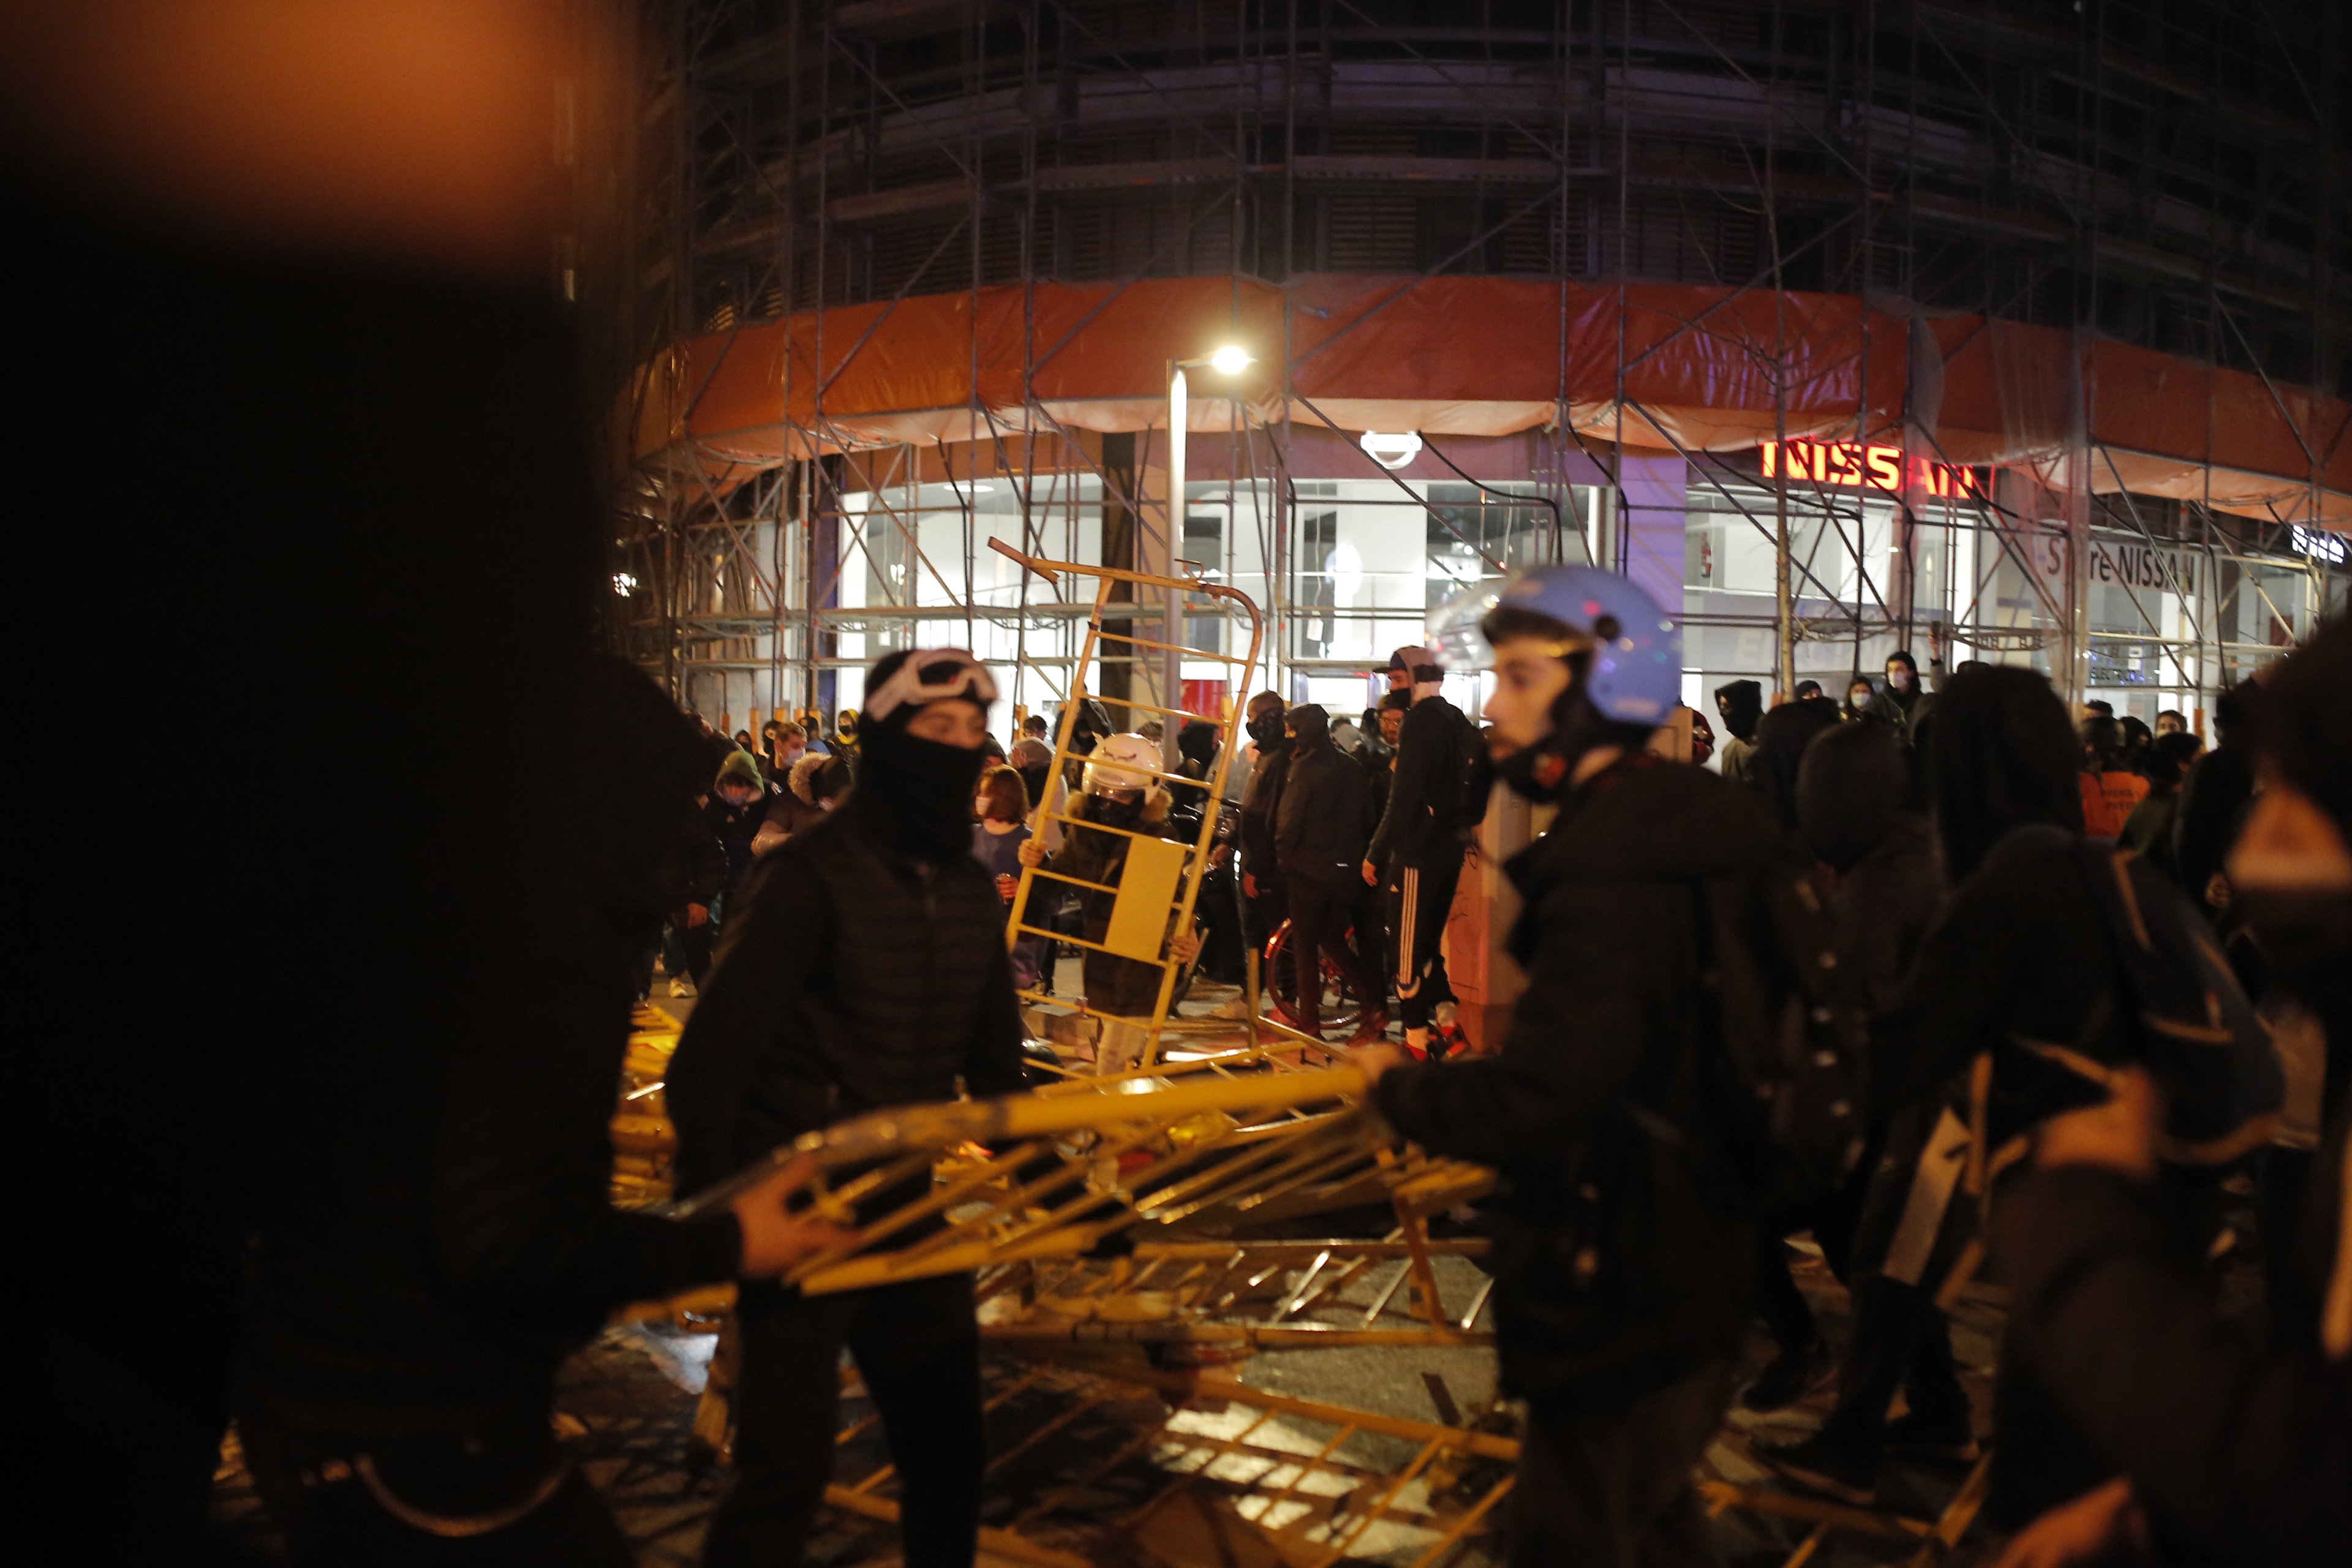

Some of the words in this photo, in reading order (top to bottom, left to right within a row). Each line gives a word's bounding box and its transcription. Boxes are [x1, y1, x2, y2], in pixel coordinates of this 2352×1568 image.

[1762, 441, 1974, 499] NISSAN
[2047, 537, 2111, 581] Sre
[2118, 546, 2195, 592] NISSAN
